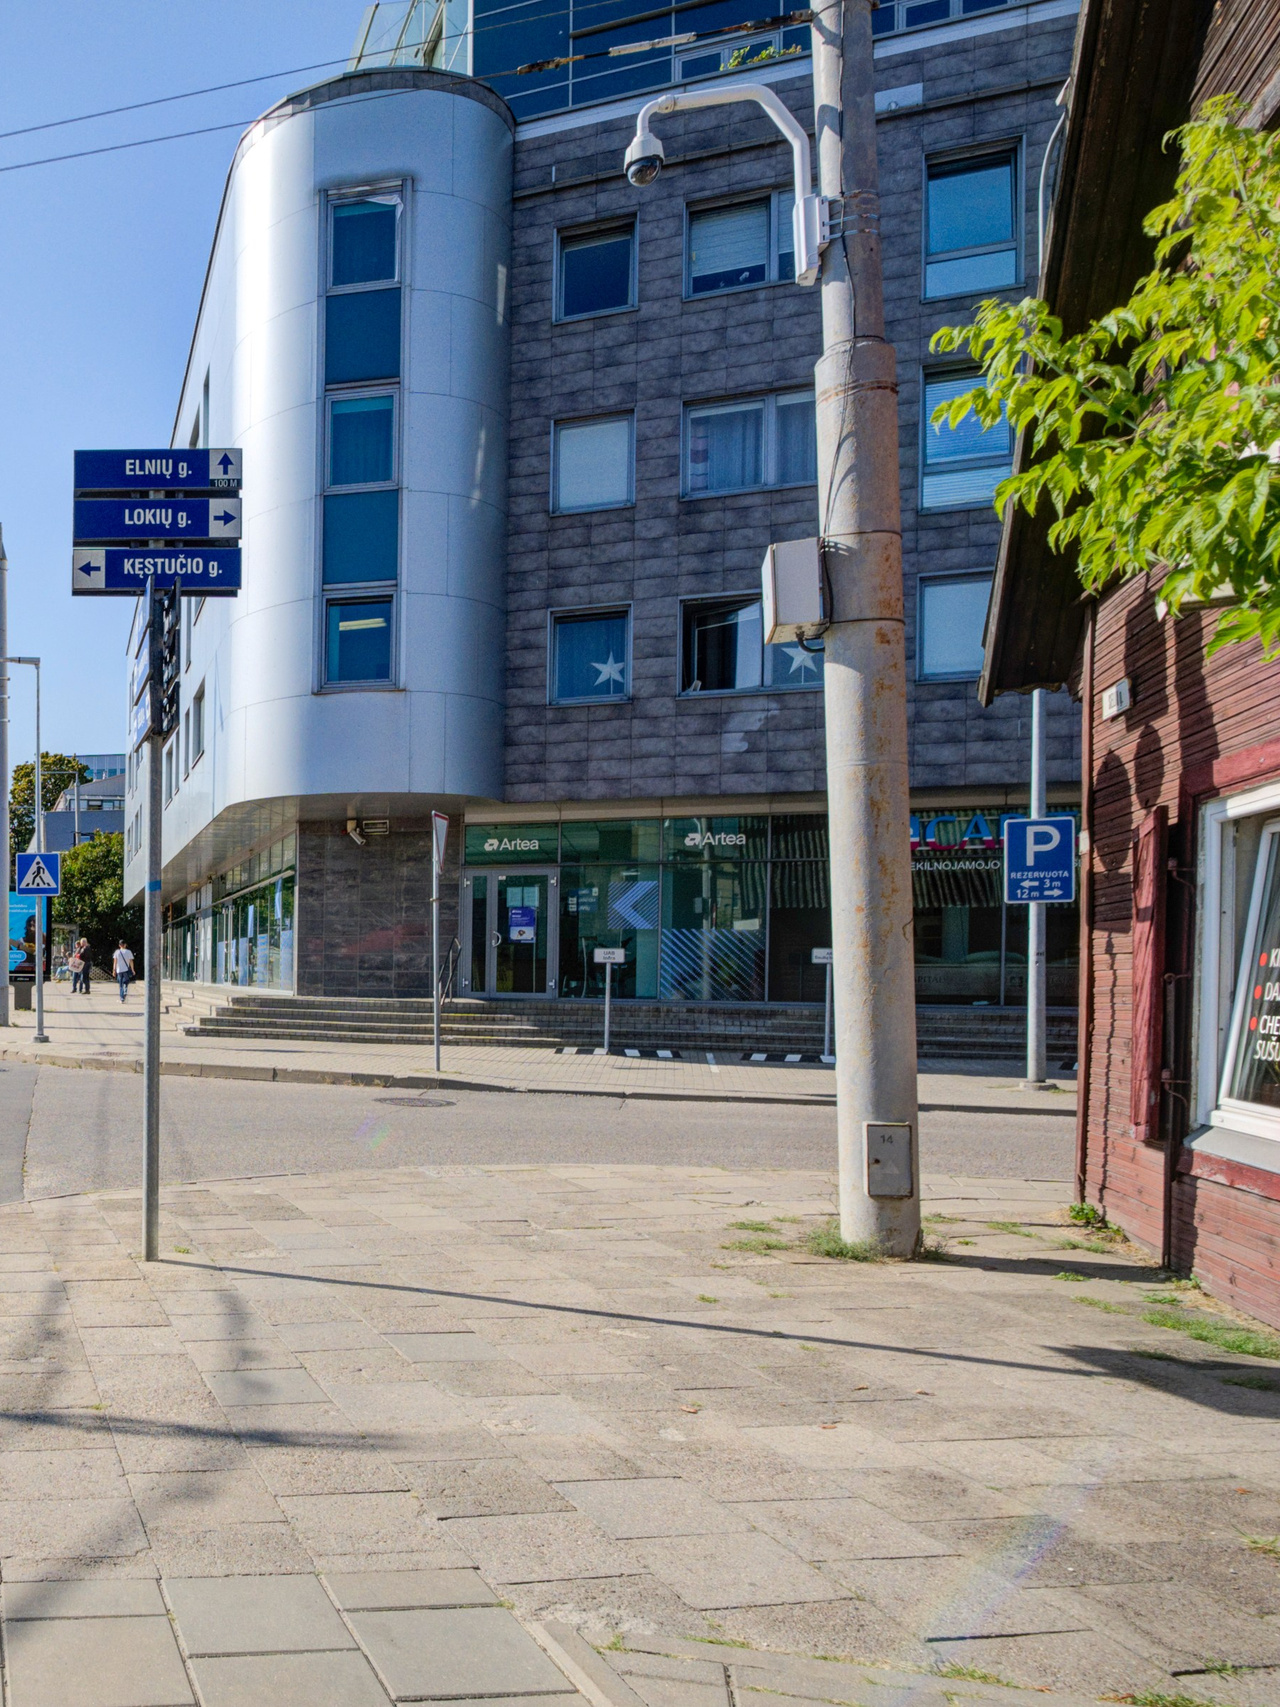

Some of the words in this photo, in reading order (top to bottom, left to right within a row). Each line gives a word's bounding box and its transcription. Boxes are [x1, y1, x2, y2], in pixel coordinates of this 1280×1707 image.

[125, 459, 173, 479] ELNIŲ
[178, 461, 193, 478] g.
[214, 479, 228, 488] 100
[124, 508, 172, 529] LOKIŲ
[177, 511, 192, 527] g.
[124, 554, 203, 578] KĘSTUČIO
[208, 560, 223, 578] g.
[499, 838, 539, 851] Artea
[701, 832, 747, 846] Artea
[1026, 825, 1061, 867] P
[911, 860, 1001, 871] EKILNOJAMOJO
[1010, 870, 1069, 879] REZERVUOTA
[1043, 879, 1050, 888] 3
[1016, 889, 1029, 898] 12
[881, 1134, 894, 1144] 14
